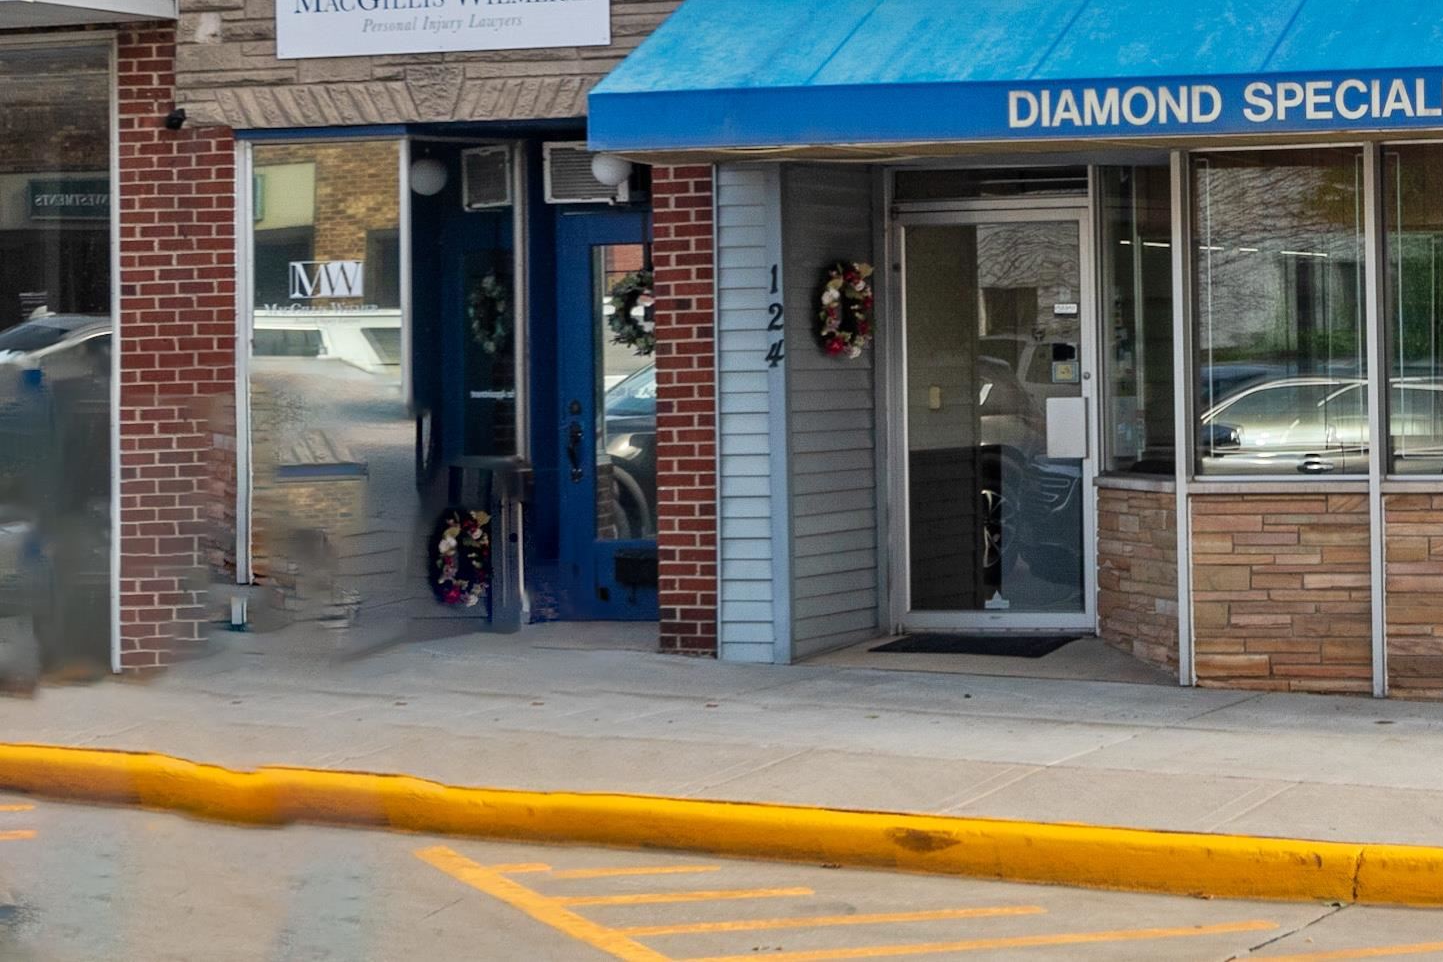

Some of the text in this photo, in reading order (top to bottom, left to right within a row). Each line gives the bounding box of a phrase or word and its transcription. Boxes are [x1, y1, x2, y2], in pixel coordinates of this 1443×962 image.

[362, 13, 522, 34] Personal Injury Lawyers
[1008, 85, 1222, 129] DIAMOND
[289, 260, 364, 298] MW
[765, 264, 785, 368] 124
